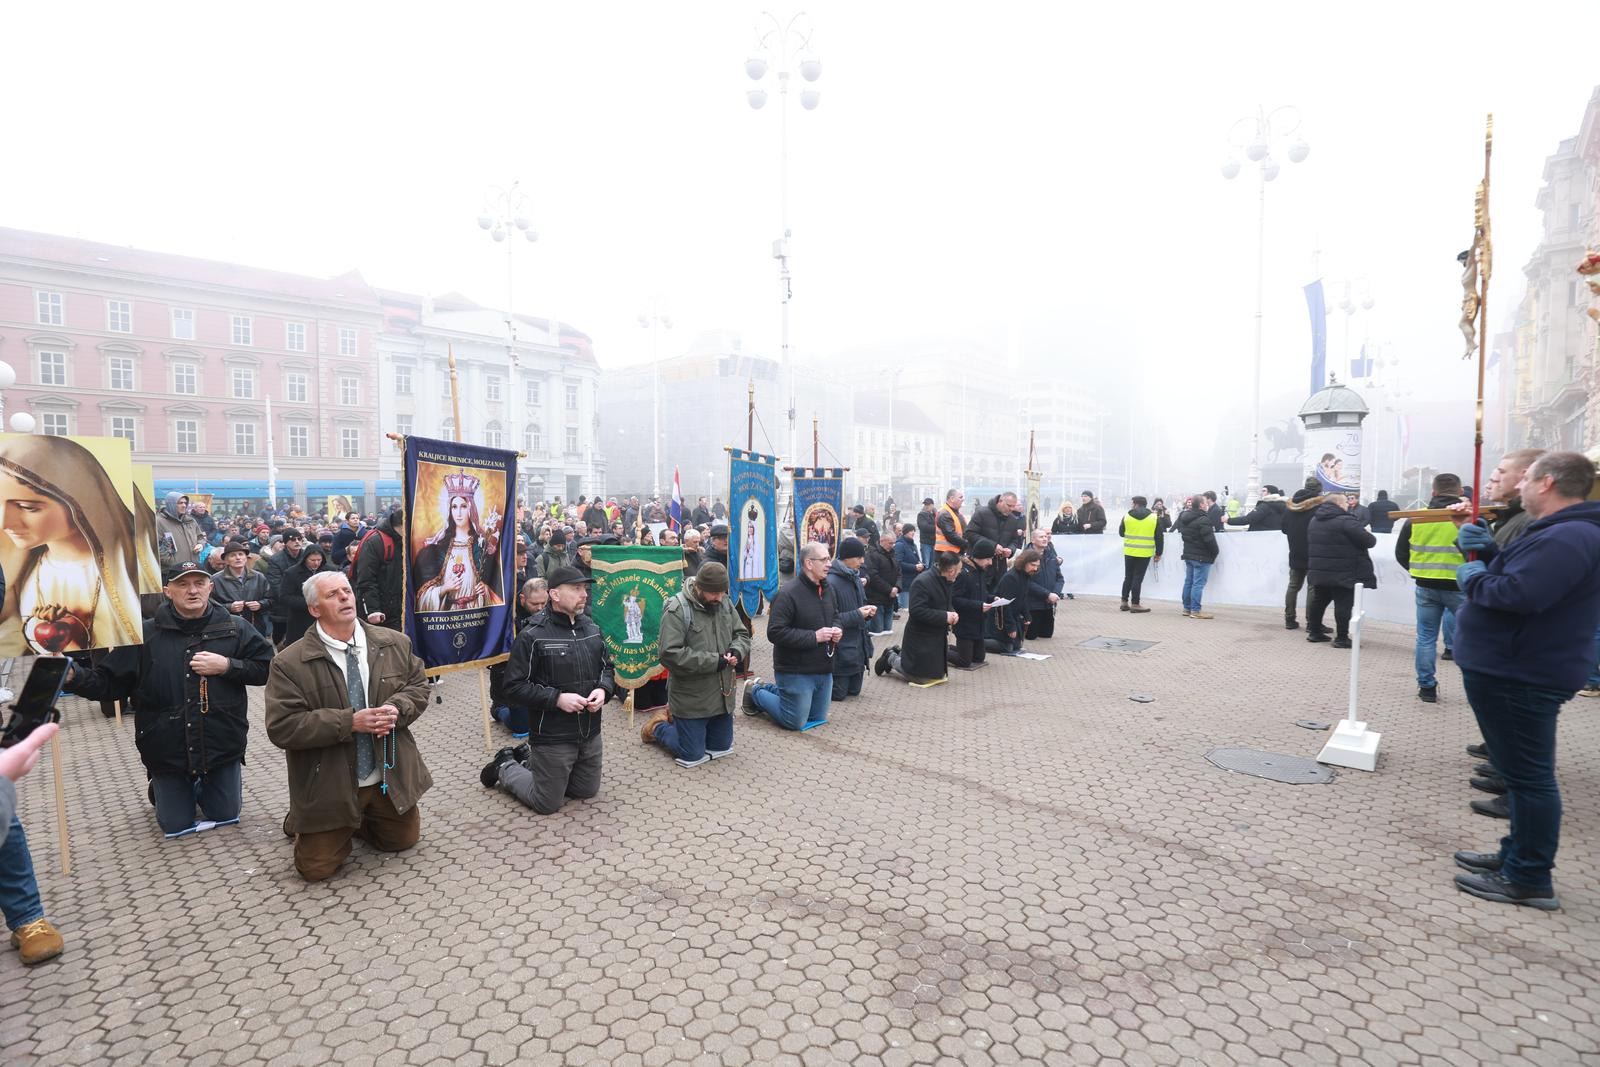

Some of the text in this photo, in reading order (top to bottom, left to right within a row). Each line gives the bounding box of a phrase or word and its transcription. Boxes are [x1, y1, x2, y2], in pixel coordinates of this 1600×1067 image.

[418, 451, 447, 461] KRALJICE
[597, 586, 612, 607] Sveti
[605, 635, 622, 653] brani
[623, 646, 638, 655] nas
